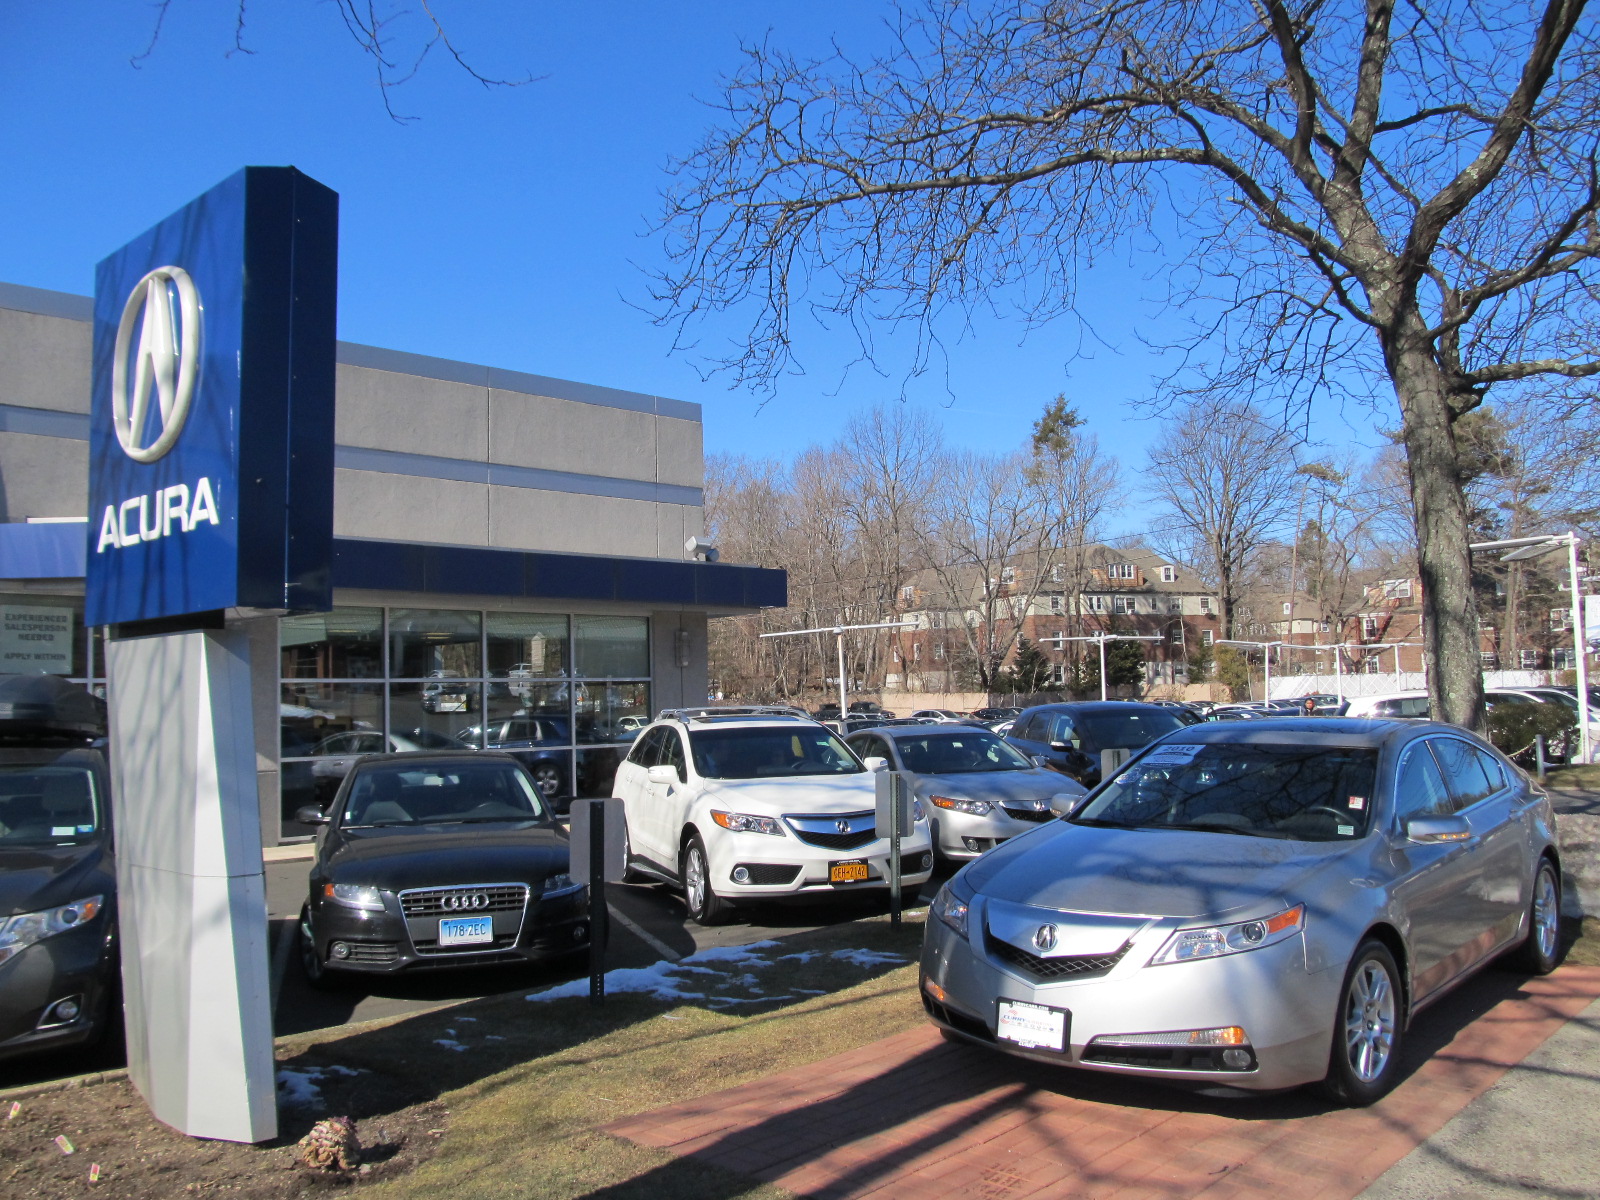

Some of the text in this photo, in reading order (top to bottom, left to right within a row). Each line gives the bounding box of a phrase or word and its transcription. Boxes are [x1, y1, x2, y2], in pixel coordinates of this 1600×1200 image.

[97, 477, 220, 553] ACURA
[5, 613, 68, 623] EXPERIENCED
[5, 623, 68, 632] SALESPERSON
[18, 633, 55, 642] NEEDED
[4, 652, 66, 661] APPLY WITHIN
